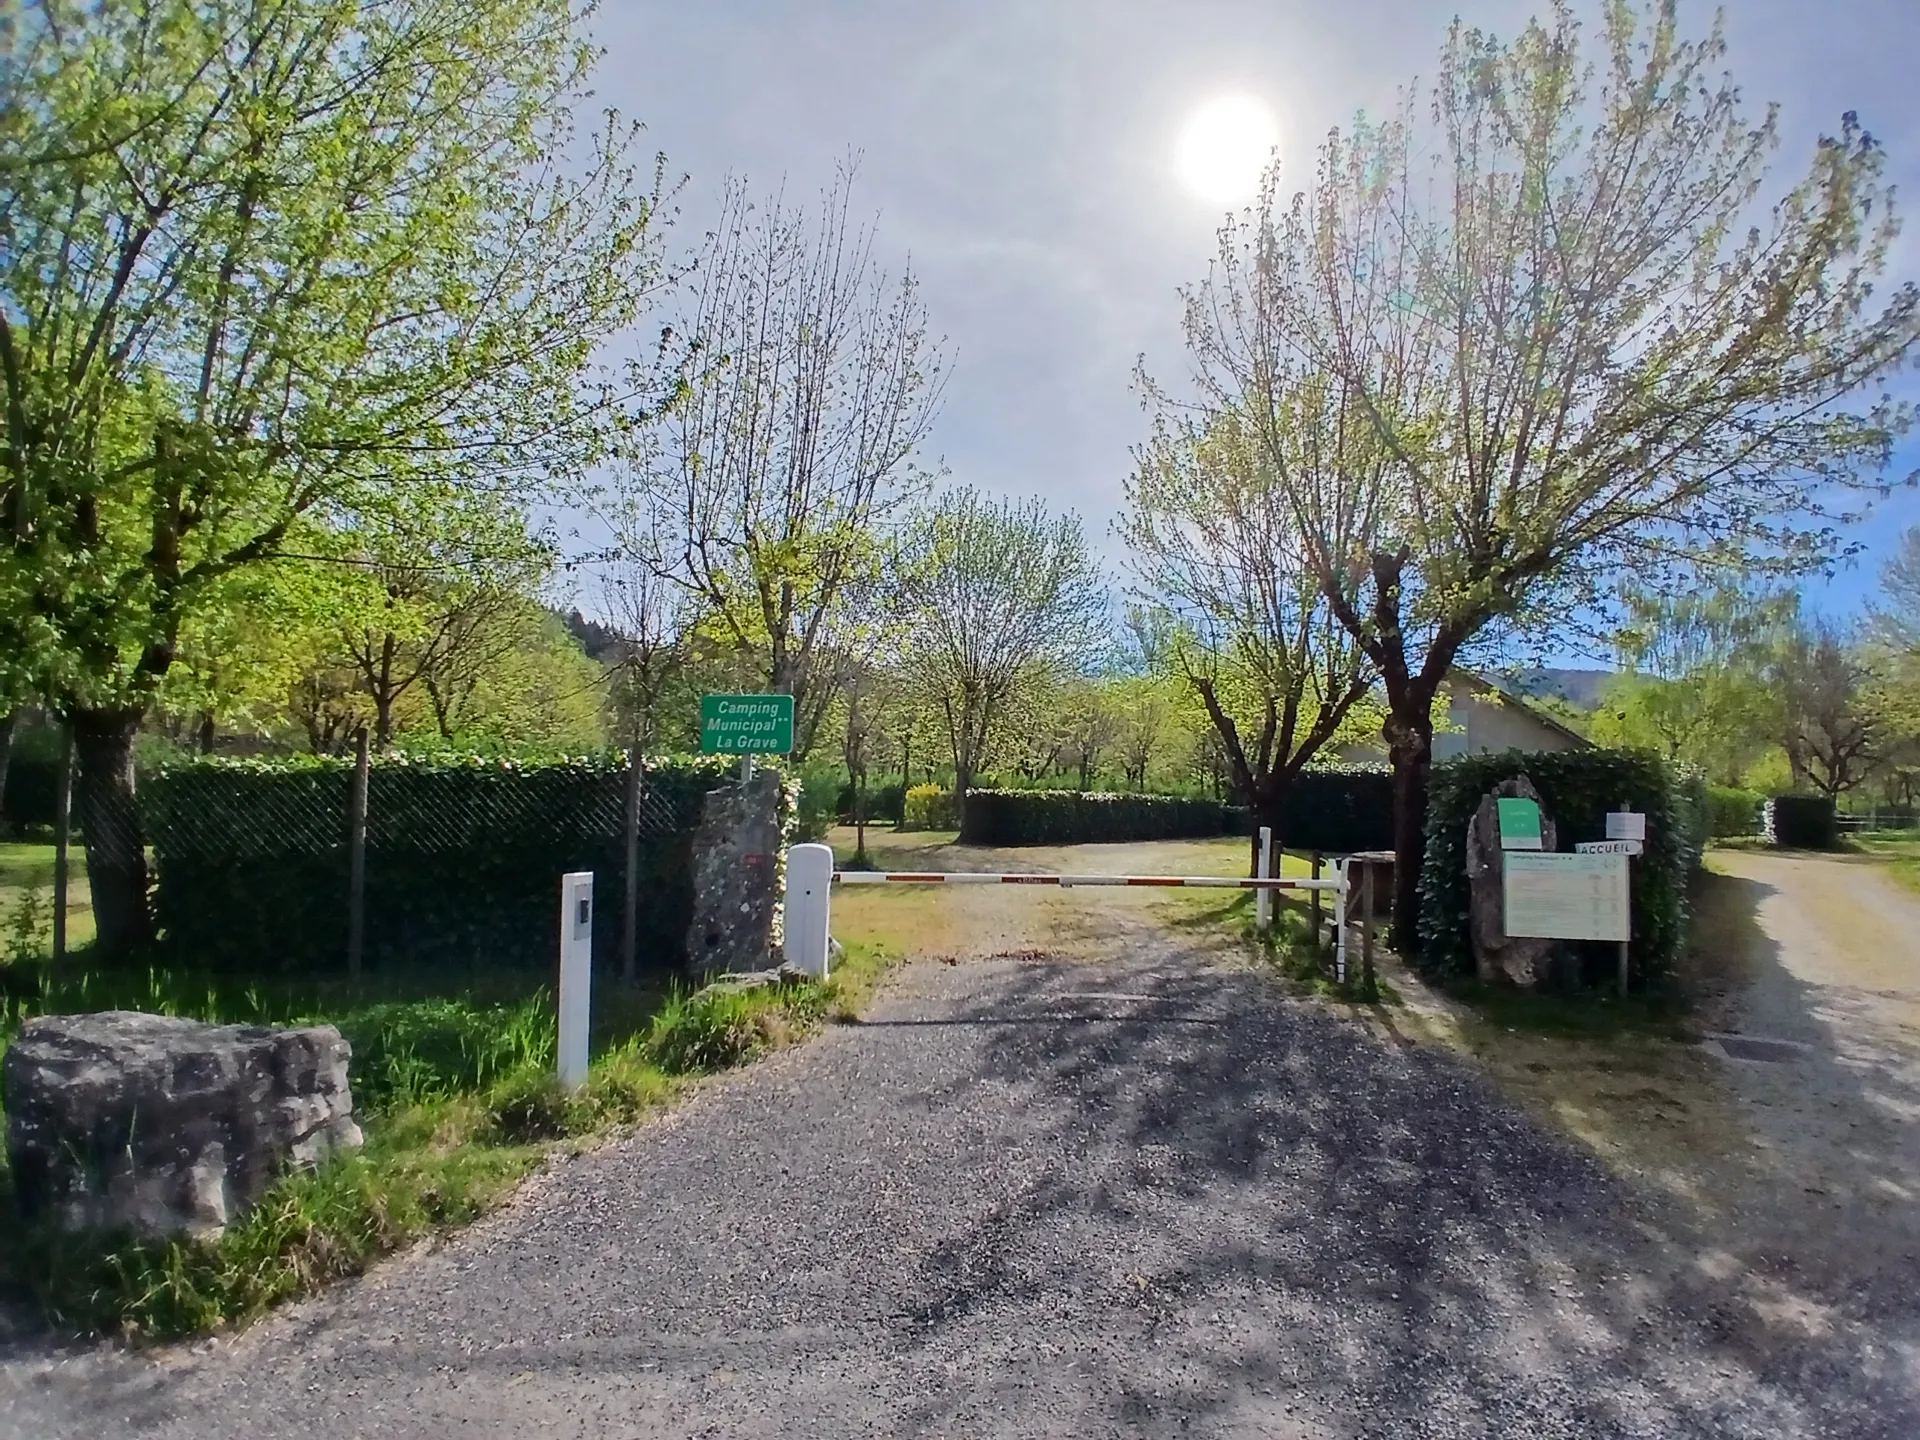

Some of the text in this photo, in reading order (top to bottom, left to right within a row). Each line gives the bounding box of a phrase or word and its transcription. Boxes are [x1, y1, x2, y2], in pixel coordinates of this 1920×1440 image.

[718, 701, 779, 718] Camping
[707, 718, 777, 734] Municipal
[716, 735, 778, 748] La Grave
[1581, 843, 1631, 855] ACCUEIL
